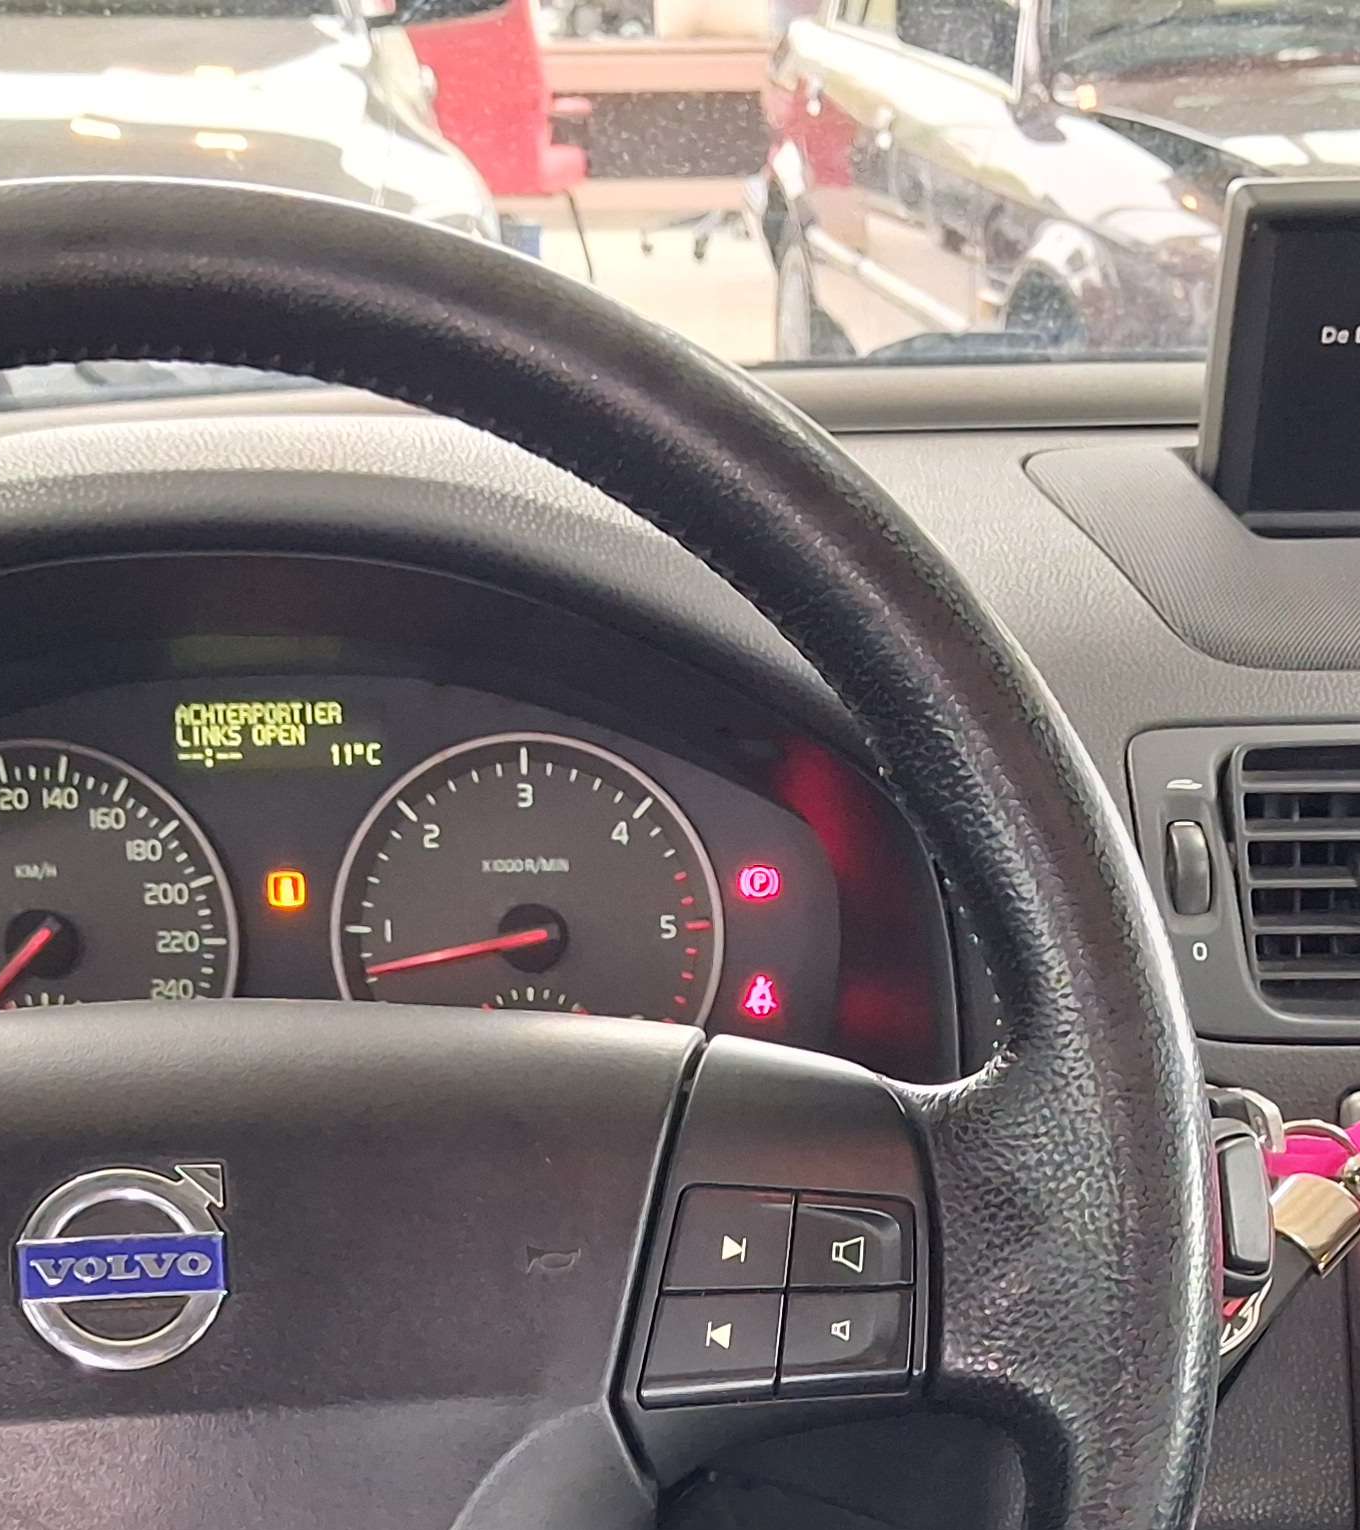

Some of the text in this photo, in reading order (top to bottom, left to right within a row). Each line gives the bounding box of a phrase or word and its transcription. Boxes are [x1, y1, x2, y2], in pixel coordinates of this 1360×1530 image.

[1321, 326, 1349, 344] De
[175, 702, 343, 725] ACHTERPORTIER
[176, 724, 306, 747] LINKS OPEN
[42, 788, 79, 809] 140
[516, 783, 534, 808] 3
[89, 808, 126, 830] 160
[422, 824, 441, 849] 2
[611, 821, 630, 846] 4
[126, 840, 162, 862] 180
[144, 884, 189, 905] 200
[659, 915, 677, 939] 5
[156, 932, 200, 953] 220
[150, 979, 194, 1000] 240
[29, 1251, 213, 1287] VOLVO
